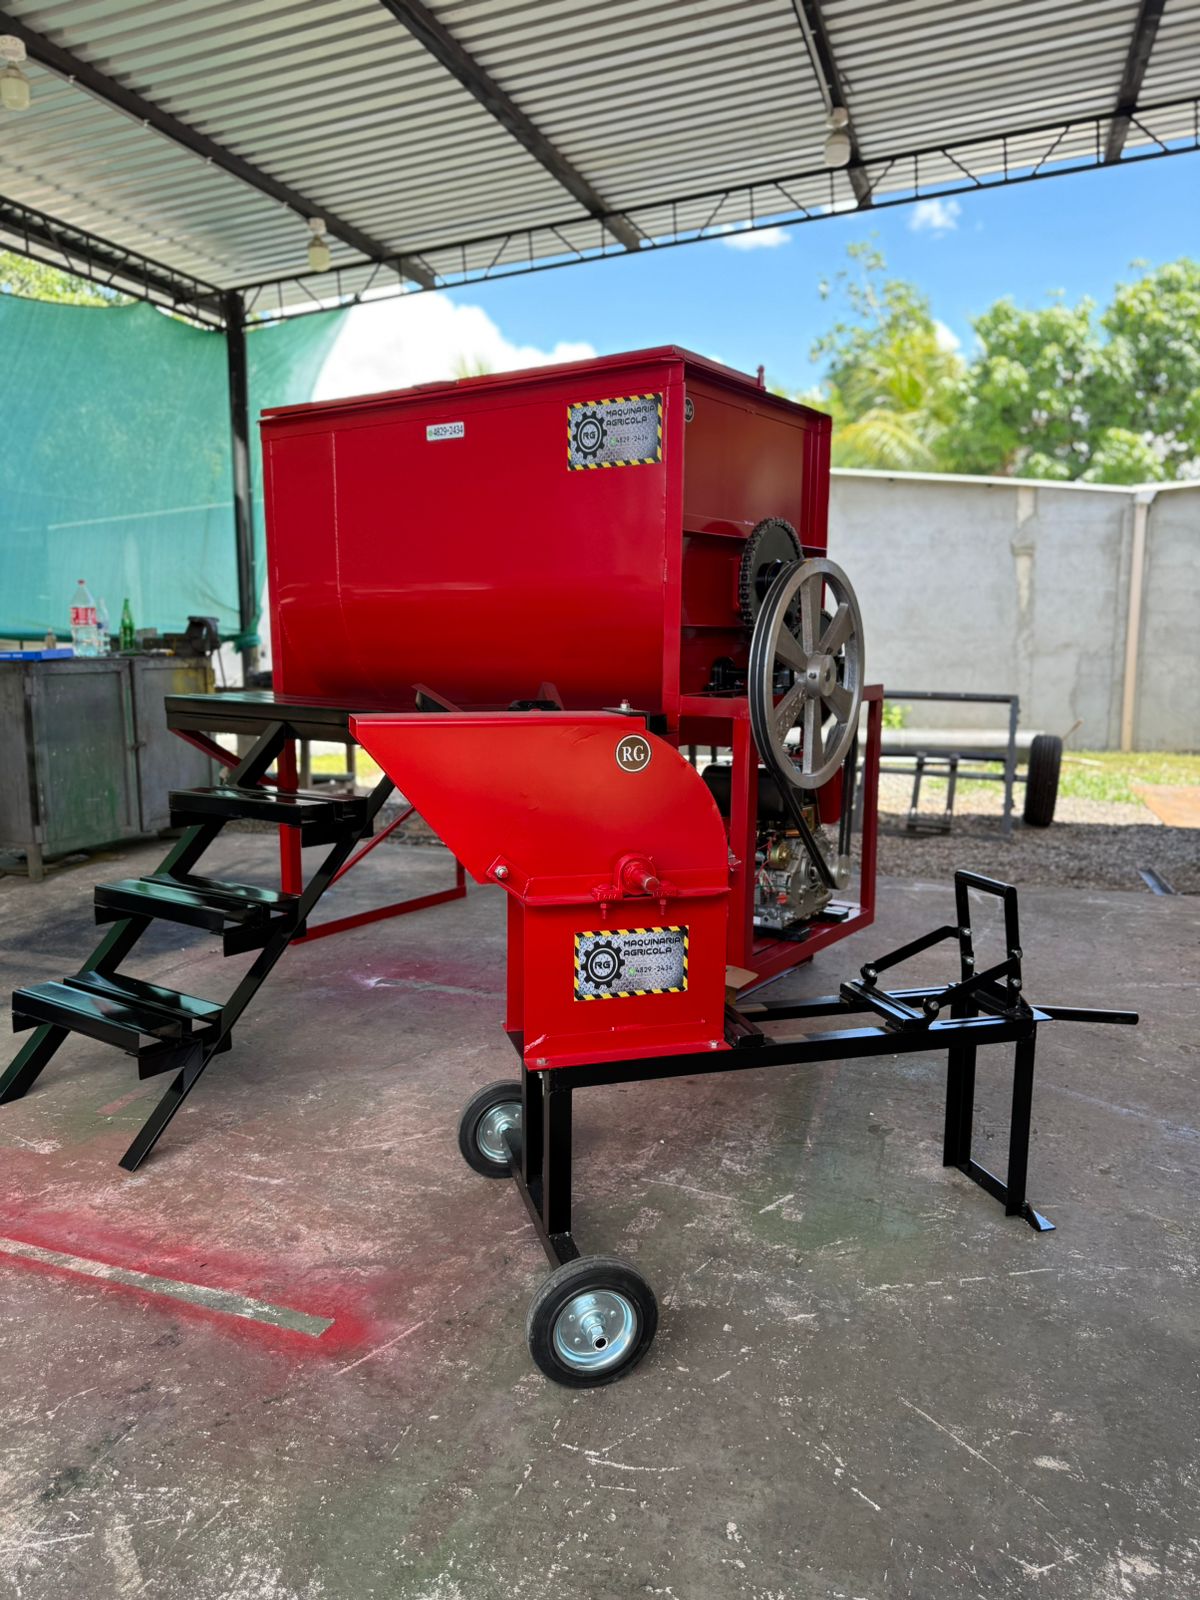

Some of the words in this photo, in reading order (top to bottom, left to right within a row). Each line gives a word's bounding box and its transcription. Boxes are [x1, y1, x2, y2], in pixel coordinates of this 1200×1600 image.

[606, 405, 655, 417] MAQUINARIA
[606, 416, 647, 427] AGRICOLA
[433, 424, 463, 436] 4829-2434
[582, 431, 596, 440] RG
[622, 745, 645, 762] RG
[623, 936, 681, 947] MAQUINARIA
[623, 947, 672, 957] AGRICOLA
[594, 961, 611, 969] RG
